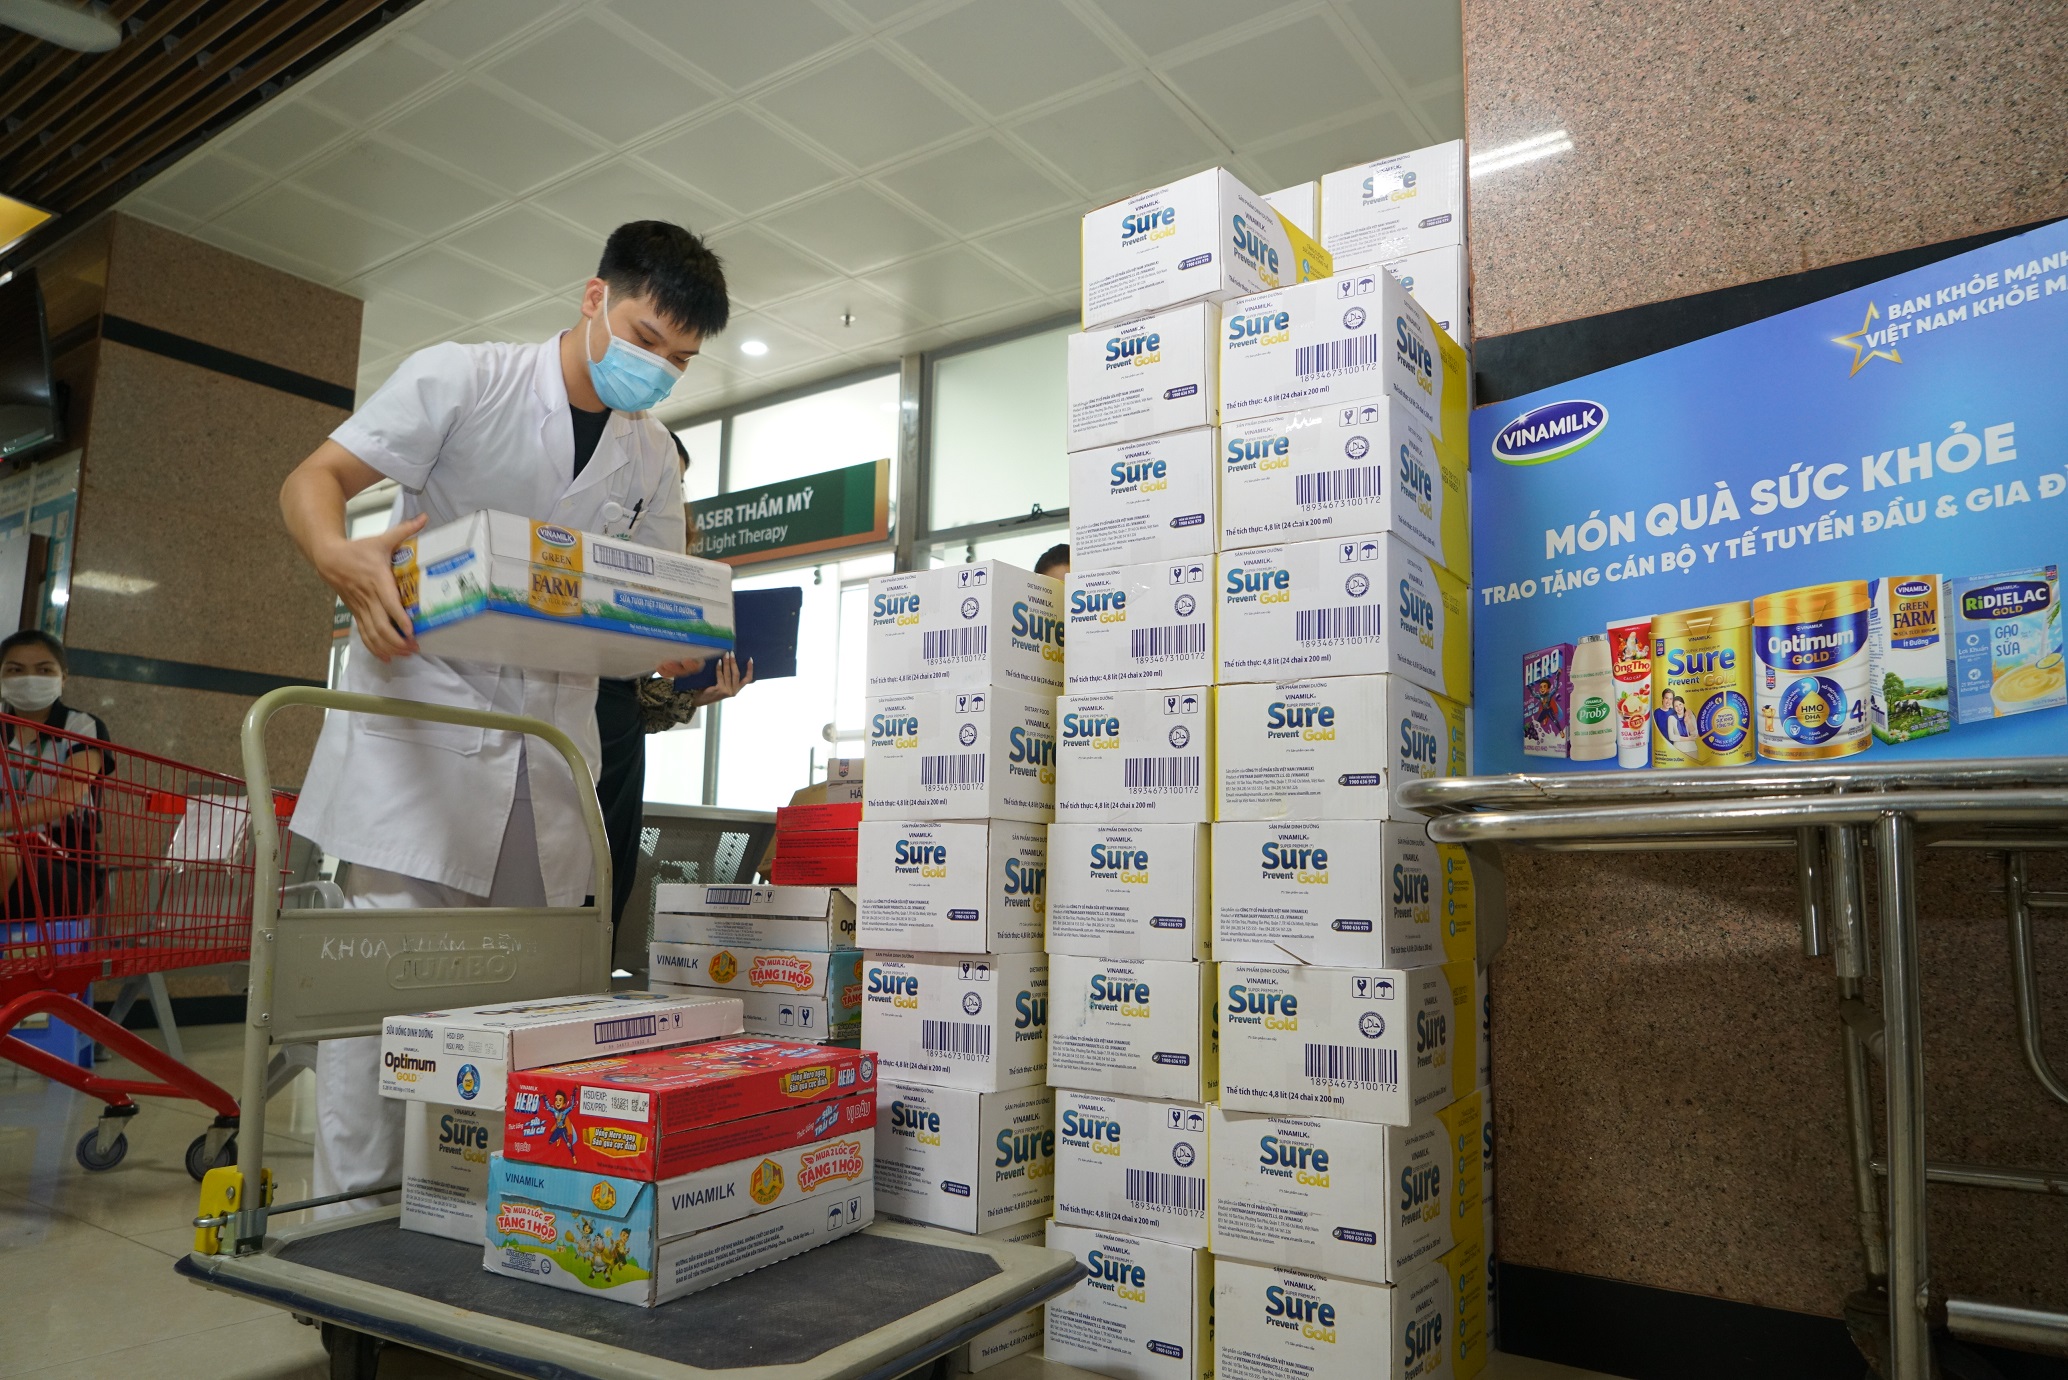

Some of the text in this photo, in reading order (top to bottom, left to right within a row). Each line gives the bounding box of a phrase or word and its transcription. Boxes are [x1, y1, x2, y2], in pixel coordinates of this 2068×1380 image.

[1122, 205, 1175, 239] Sure
[1888, 294, 1931, 320] BẠN
[1937, 273, 1999, 305] KHỎE
[1229, 310, 1290, 340] Sure
[1865, 321, 1911, 348] VIỆT
[1916, 305, 1967, 334] NAM
[1973, 283, 2039, 317] KHỎE
[1105, 333, 1160, 362] Sure
[1503, 408, 1597, 449] VINAMILK
[1227, 434, 1289, 464] Sure
[1110, 459, 1167, 487] Sure
[1546, 510, 1635, 559] MÓN
[1645, 481, 1740, 536] QUÀ
[1750, 462, 1849, 515] SỨC
[1861, 421, 2017, 492] KHỎE
[736, 493, 782, 524] THẨM
[787, 487, 814, 513] MỸ
[540, 528, 572, 543] VINAMILK
[707, 531, 736, 553] Light
[740, 525, 788, 544] Therapy
[1482, 579, 1537, 605] TRAO
[1541, 567, 1600, 598] TẶNG
[1605, 554, 1654, 581] CÁN
[1661, 544, 1696, 574] BỘ
[1702, 542, 1720, 563] Y
[1725, 526, 1759, 559] TẾ
[1762, 509, 1854, 552] TUYẾN
[1861, 497, 1927, 533] ĐẦU
[1935, 495, 1958, 518] &
[1966, 481, 2031, 511] GIA
[542, 552, 571, 565] GREEN
[532, 573, 579, 599] FARM
[1226, 568, 1289, 594] Sure
[1898, 585, 1929, 593] VINAMILK
[620, 594, 630, 604] SỮA
[656, 601, 672, 612] TRÙNG
[873, 593, 919, 618] Sure
[1070, 589, 1126, 614] Sure
[1899, 601, 1928, 610] GREEN
[1966, 588, 2047, 611] RiDIELAC
[1993, 606, 2023, 616] GOLD
[1893, 610, 1935, 629] FARM
[1995, 624, 2018, 639] GẠO
[1768, 630, 1854, 658] Optimum
[1904, 638, 1929, 647] Ít Đường
[1996, 638, 2020, 656] SỮA
[1526, 649, 1560, 686] HERO
[1668, 648, 1735, 676] Sure
[1792, 652, 1829, 665] GOLD
[1668, 671, 1735, 686] Prevent Gold
[1267, 702, 1335, 729] Sure
[1580, 708, 1607, 718] Proby
[1850, 700, 1863, 722] 4
[871, 714, 918, 738] Sure
[1063, 713, 1119, 739] Sure
[895, 840, 946, 865] Sure
[1090, 844, 1148, 870] Sure
[1261, 841, 1327, 869] Sure
[321, 937, 391, 960] KHOA
[657, 955, 698, 969] VINAMILK
[786, 958, 797, 968] LỐC
[752, 969, 812, 987] TẶNG 1 HỘP
[868, 968, 918, 996] Sure
[1090, 975, 1149, 1006] Sure
[1228, 985, 1297, 1016] Sure
[395, 1025, 406, 1036] UỐNG
[408, 1028, 417, 1038] DINH
[419, 1028, 433, 1038] DƯỠNG
[1228, 1014, 1297, 1031] Prevent Gold
[385, 1052, 436, 1072] Optimum
[396, 1072, 416, 1082] GOLD
[838, 1068, 855, 1087] HERO
[1310, 1078, 1397, 1093] 18934673100172
[515, 1092, 540, 1112] HERO
[583, 1103, 607, 1112] NSX/PRD:
[584, 1090, 607, 1101] HSD/EXP:
[1227, 1086, 1238, 1095] Thể
[1239, 1087, 1250, 1096] tích
[1252, 1088, 1268, 1099] thực:
[1269, 1091, 1279, 1099] 4,8
[1288, 1092, 1299, 1100] (24
[1300, 1093, 1313, 1102] chai
[1333, 1096, 1344, 1105] ml)
[855, 1100, 870, 1118] DÂU
[892, 1101, 940, 1132] Sure
[439, 1115, 488, 1149] Sure
[609, 1131, 622, 1139] Hero
[623, 1133, 636, 1141] ngay
[1062, 1109, 1120, 1143] Sure
[815, 1145, 847, 1162] MUA 2 LỐC
[1260, 1136, 1329, 1172] Sure
[506, 1173, 544, 1188] VINAMILK
[801, 1167, 830, 1187] TẶNG
[833, 1161, 838, 1173] 1
[839, 1157, 861, 1177] HỘP
[672, 1183, 735, 1210] VINAMILK
[531, 1209, 543, 1219] LỐC
[499, 1215, 555, 1239] TẶNG 1 HỘP
[1088, 1250, 1145, 1287] Sure
[1266, 1286, 1335, 1327] Sure
